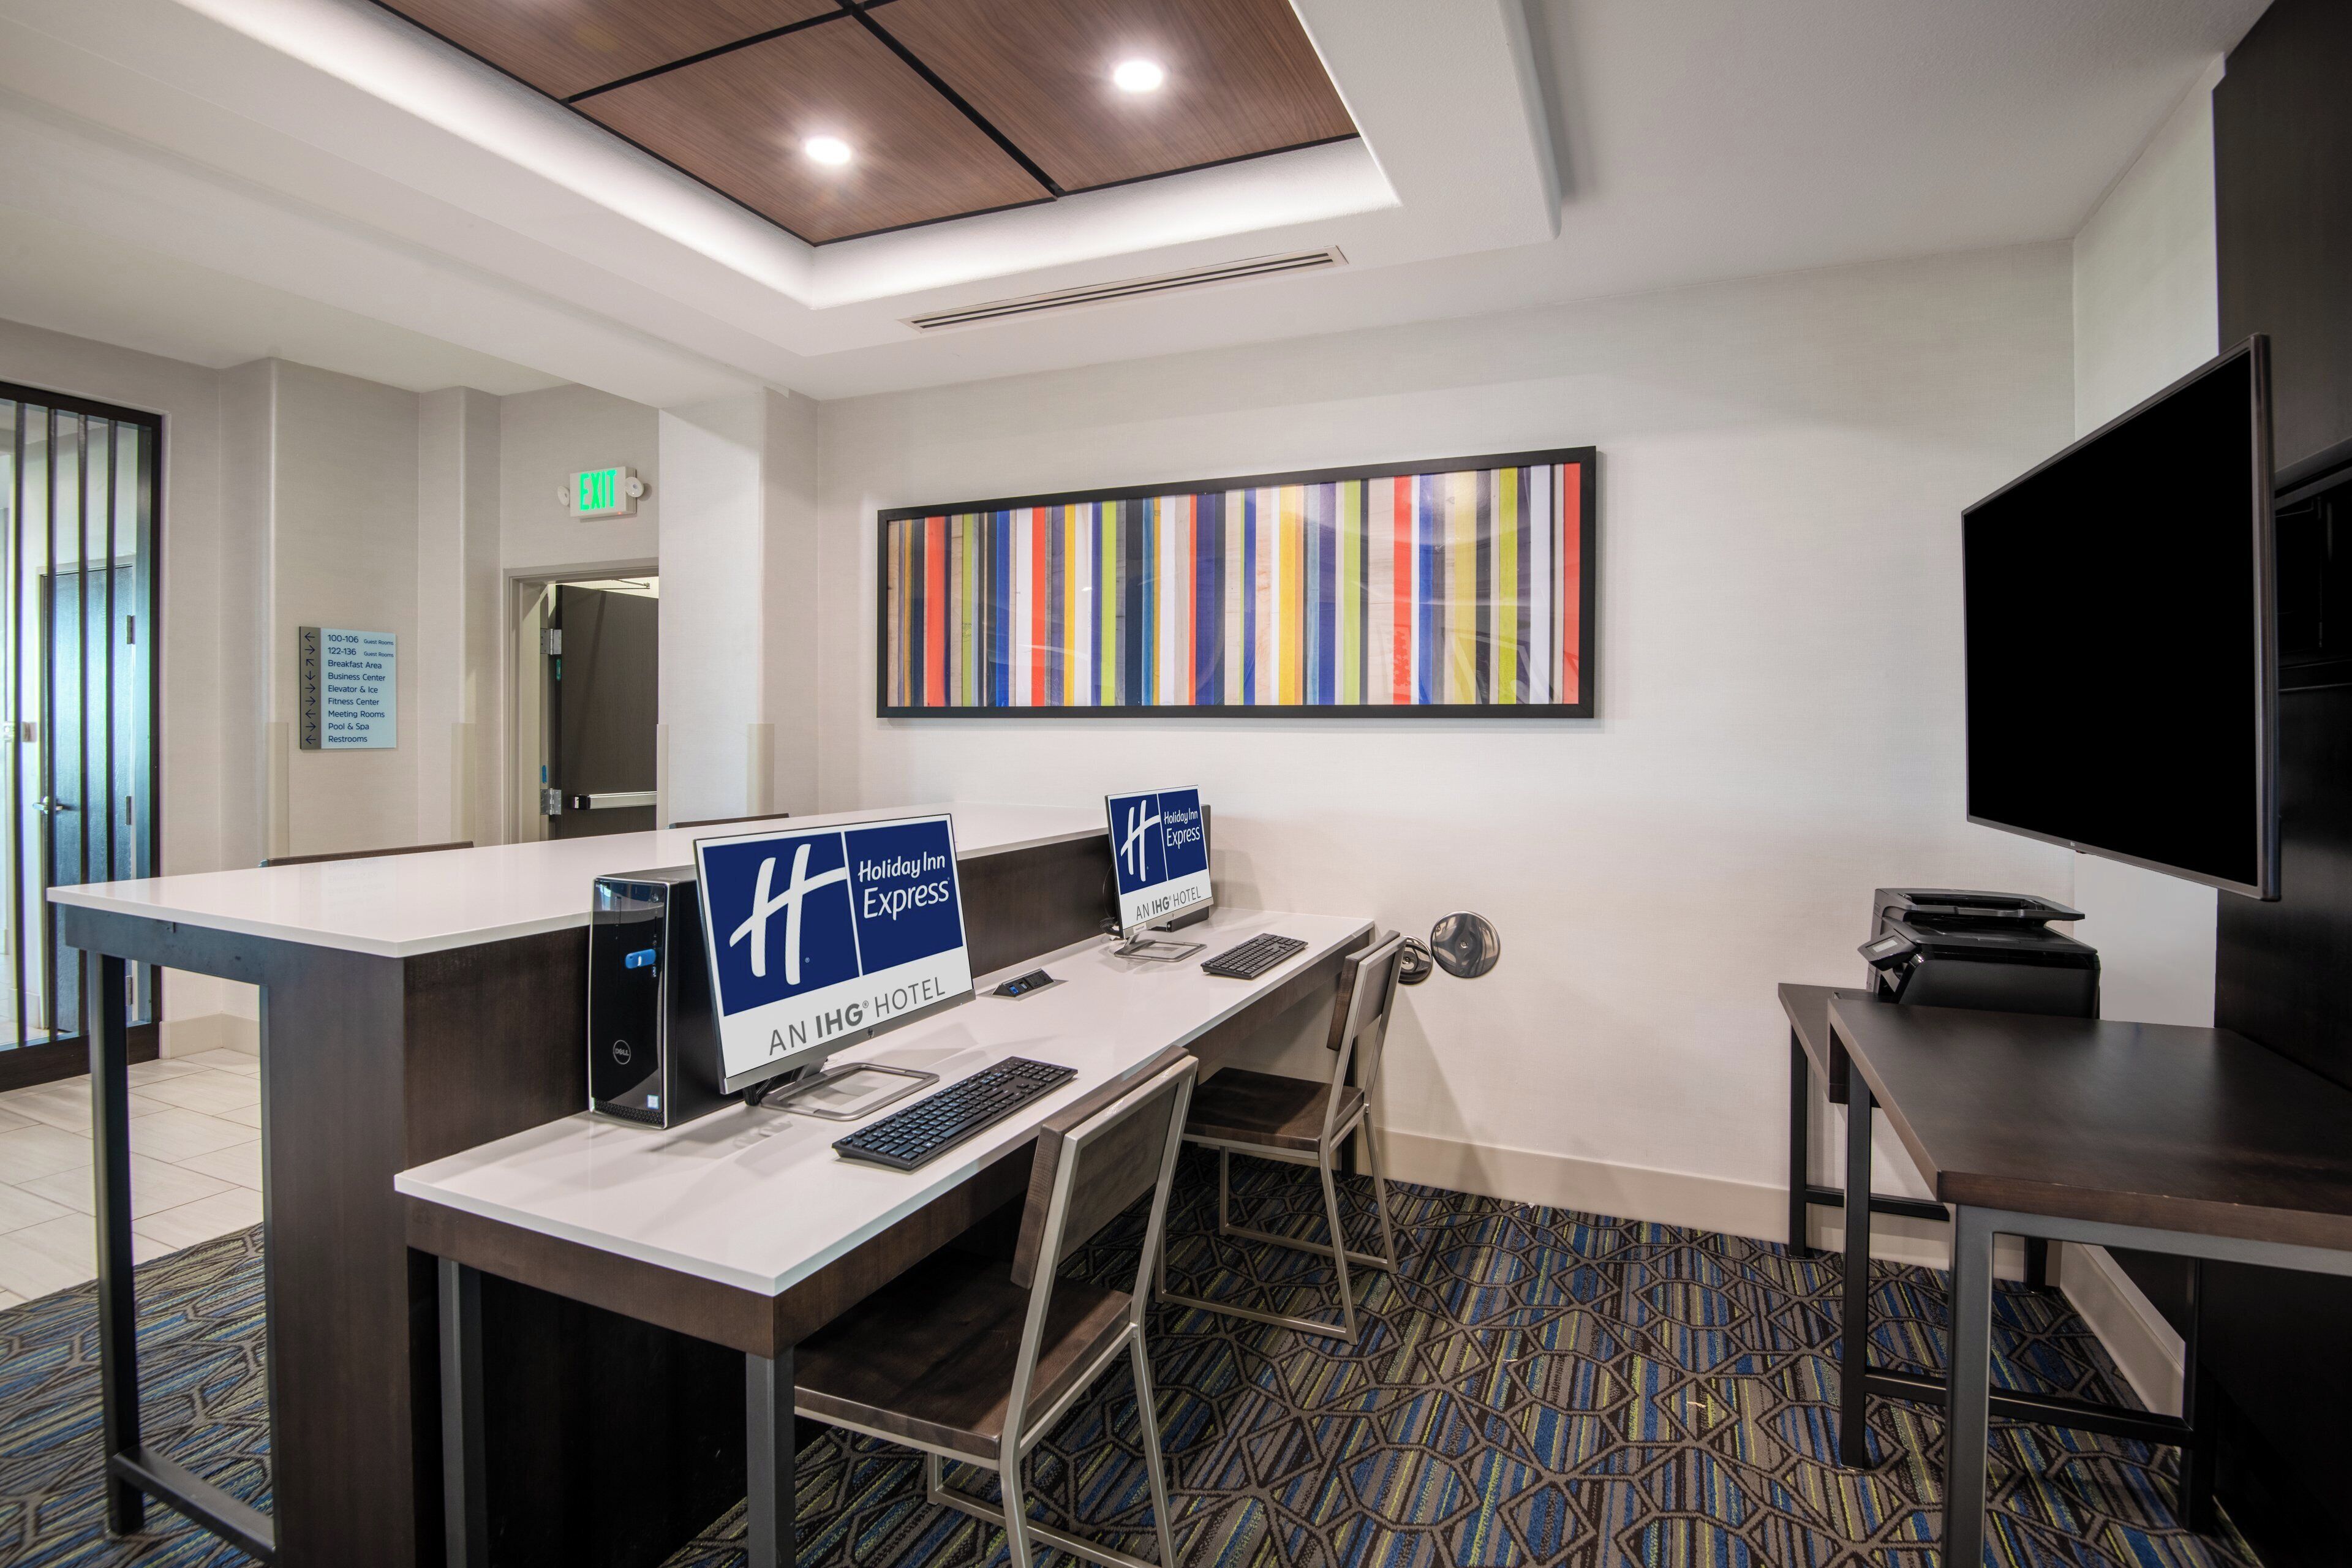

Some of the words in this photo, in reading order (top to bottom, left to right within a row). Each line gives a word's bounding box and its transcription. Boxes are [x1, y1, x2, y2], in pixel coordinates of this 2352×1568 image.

[579, 469, 617, 511] EXIT
[328, 635, 359, 643] 100-106
[328, 647, 356, 655] 122-136
[328, 660, 363, 668] Breakfast
[1164, 809, 1188, 826] Holiday
[1188, 807, 1198, 820] Inn
[1166, 826, 1200, 850] Express
[858, 856, 921, 883] Holiday
[923, 851, 945, 872] Inn
[864, 880, 949, 921] Express
[1136, 903, 1150, 921] AN
[1173, 886, 1201, 907] HOTEL
[769, 1020, 807, 1056] AN
[874, 977, 946, 1018] HOTEL
